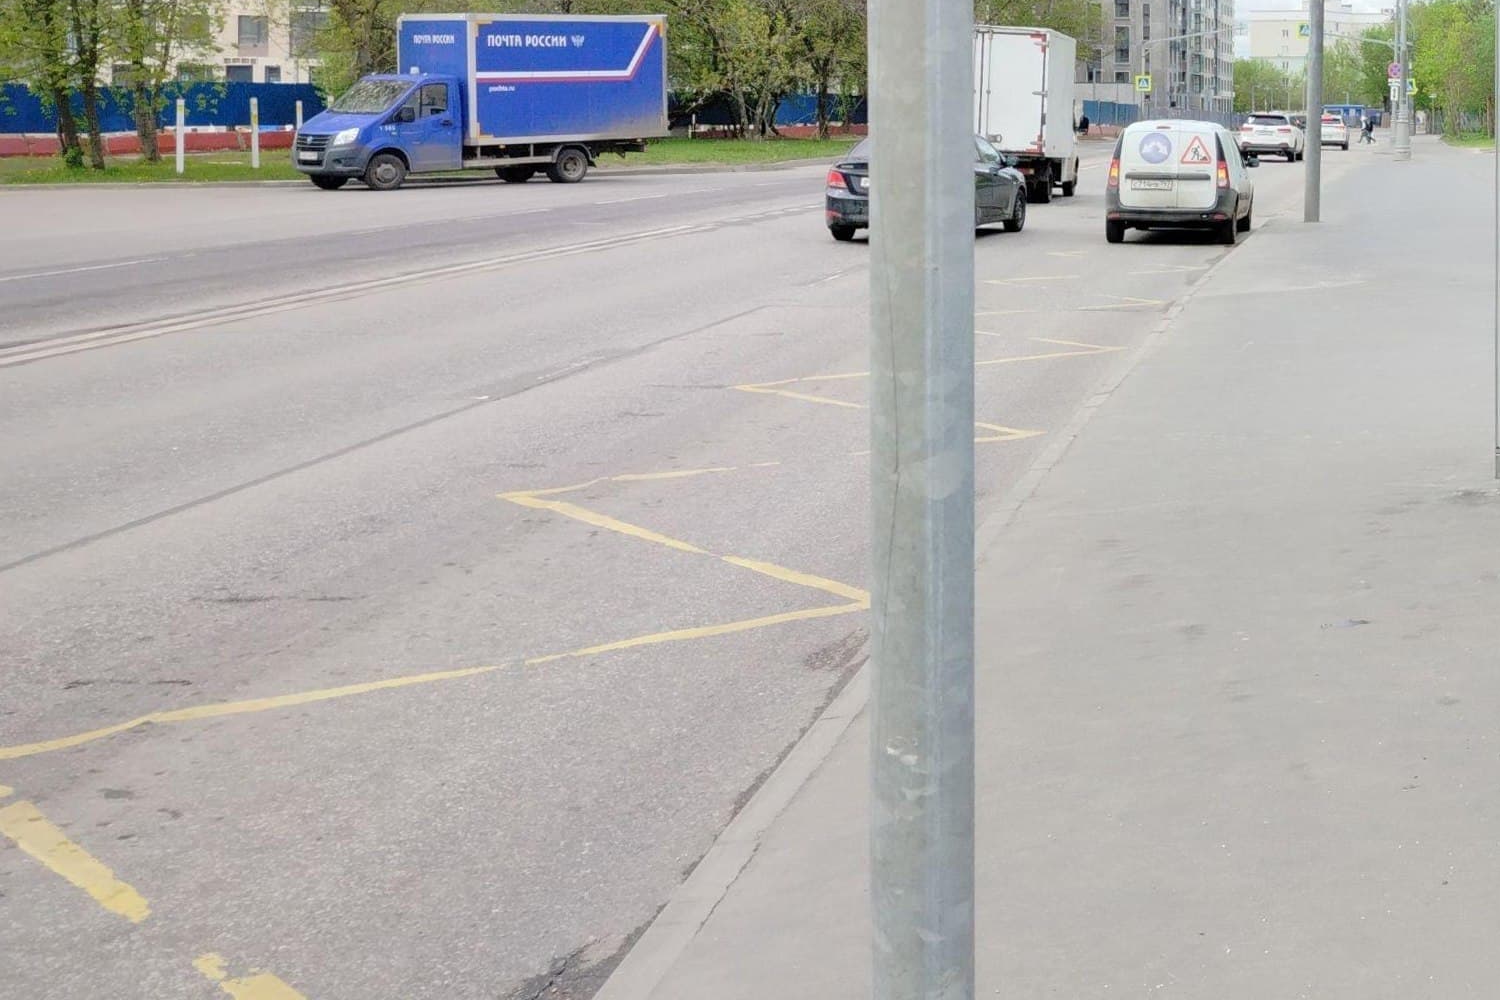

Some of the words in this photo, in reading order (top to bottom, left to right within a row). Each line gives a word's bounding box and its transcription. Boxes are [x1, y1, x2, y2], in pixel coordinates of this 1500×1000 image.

[413, 34, 431, 44] ПОЧТА
[432, 34, 455, 45] РОССИИ
[487, 34, 522, 47] ПОЧТА
[525, 34, 567, 47] РОССИИ
